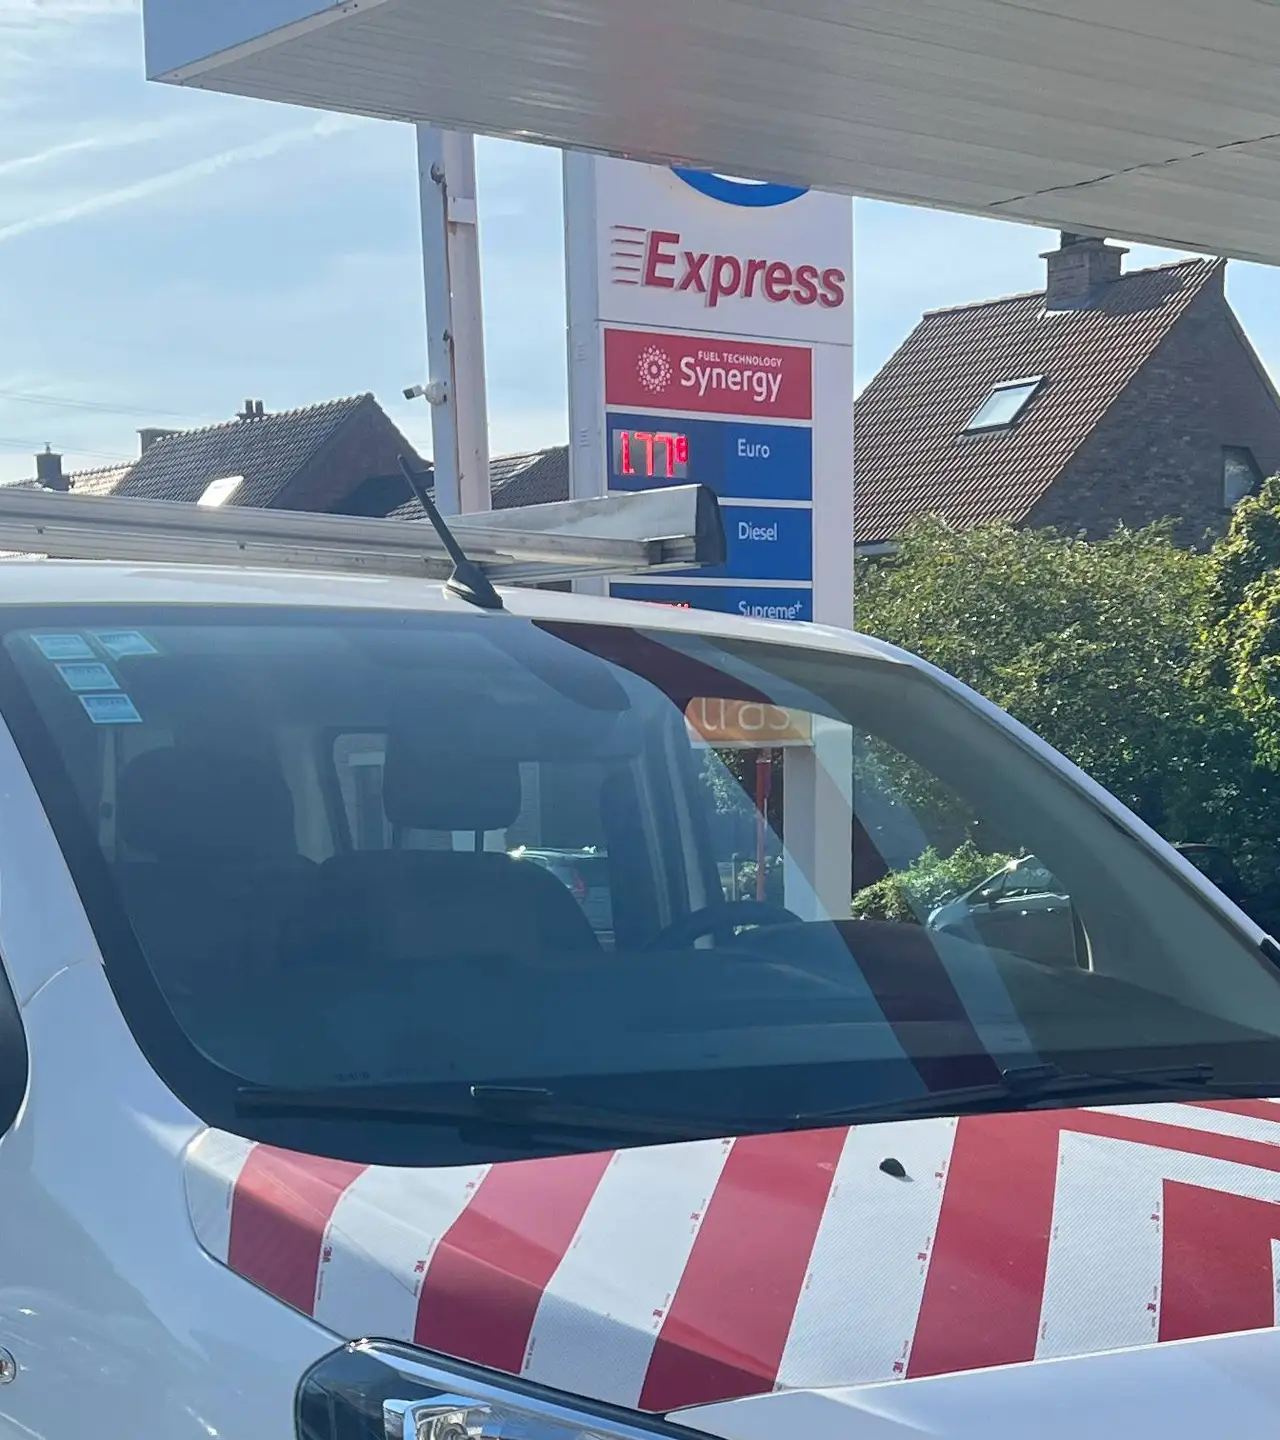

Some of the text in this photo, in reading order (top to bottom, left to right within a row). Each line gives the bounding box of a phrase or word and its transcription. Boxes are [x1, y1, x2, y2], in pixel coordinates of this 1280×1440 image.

[644, 231, 845, 308] Express
[698, 350, 782, 368] FUEL TECHNOLOGY
[680, 356, 782, 403] Synergy
[737, 438, 770, 459] Euro
[738, 521, 778, 541] Diesel
